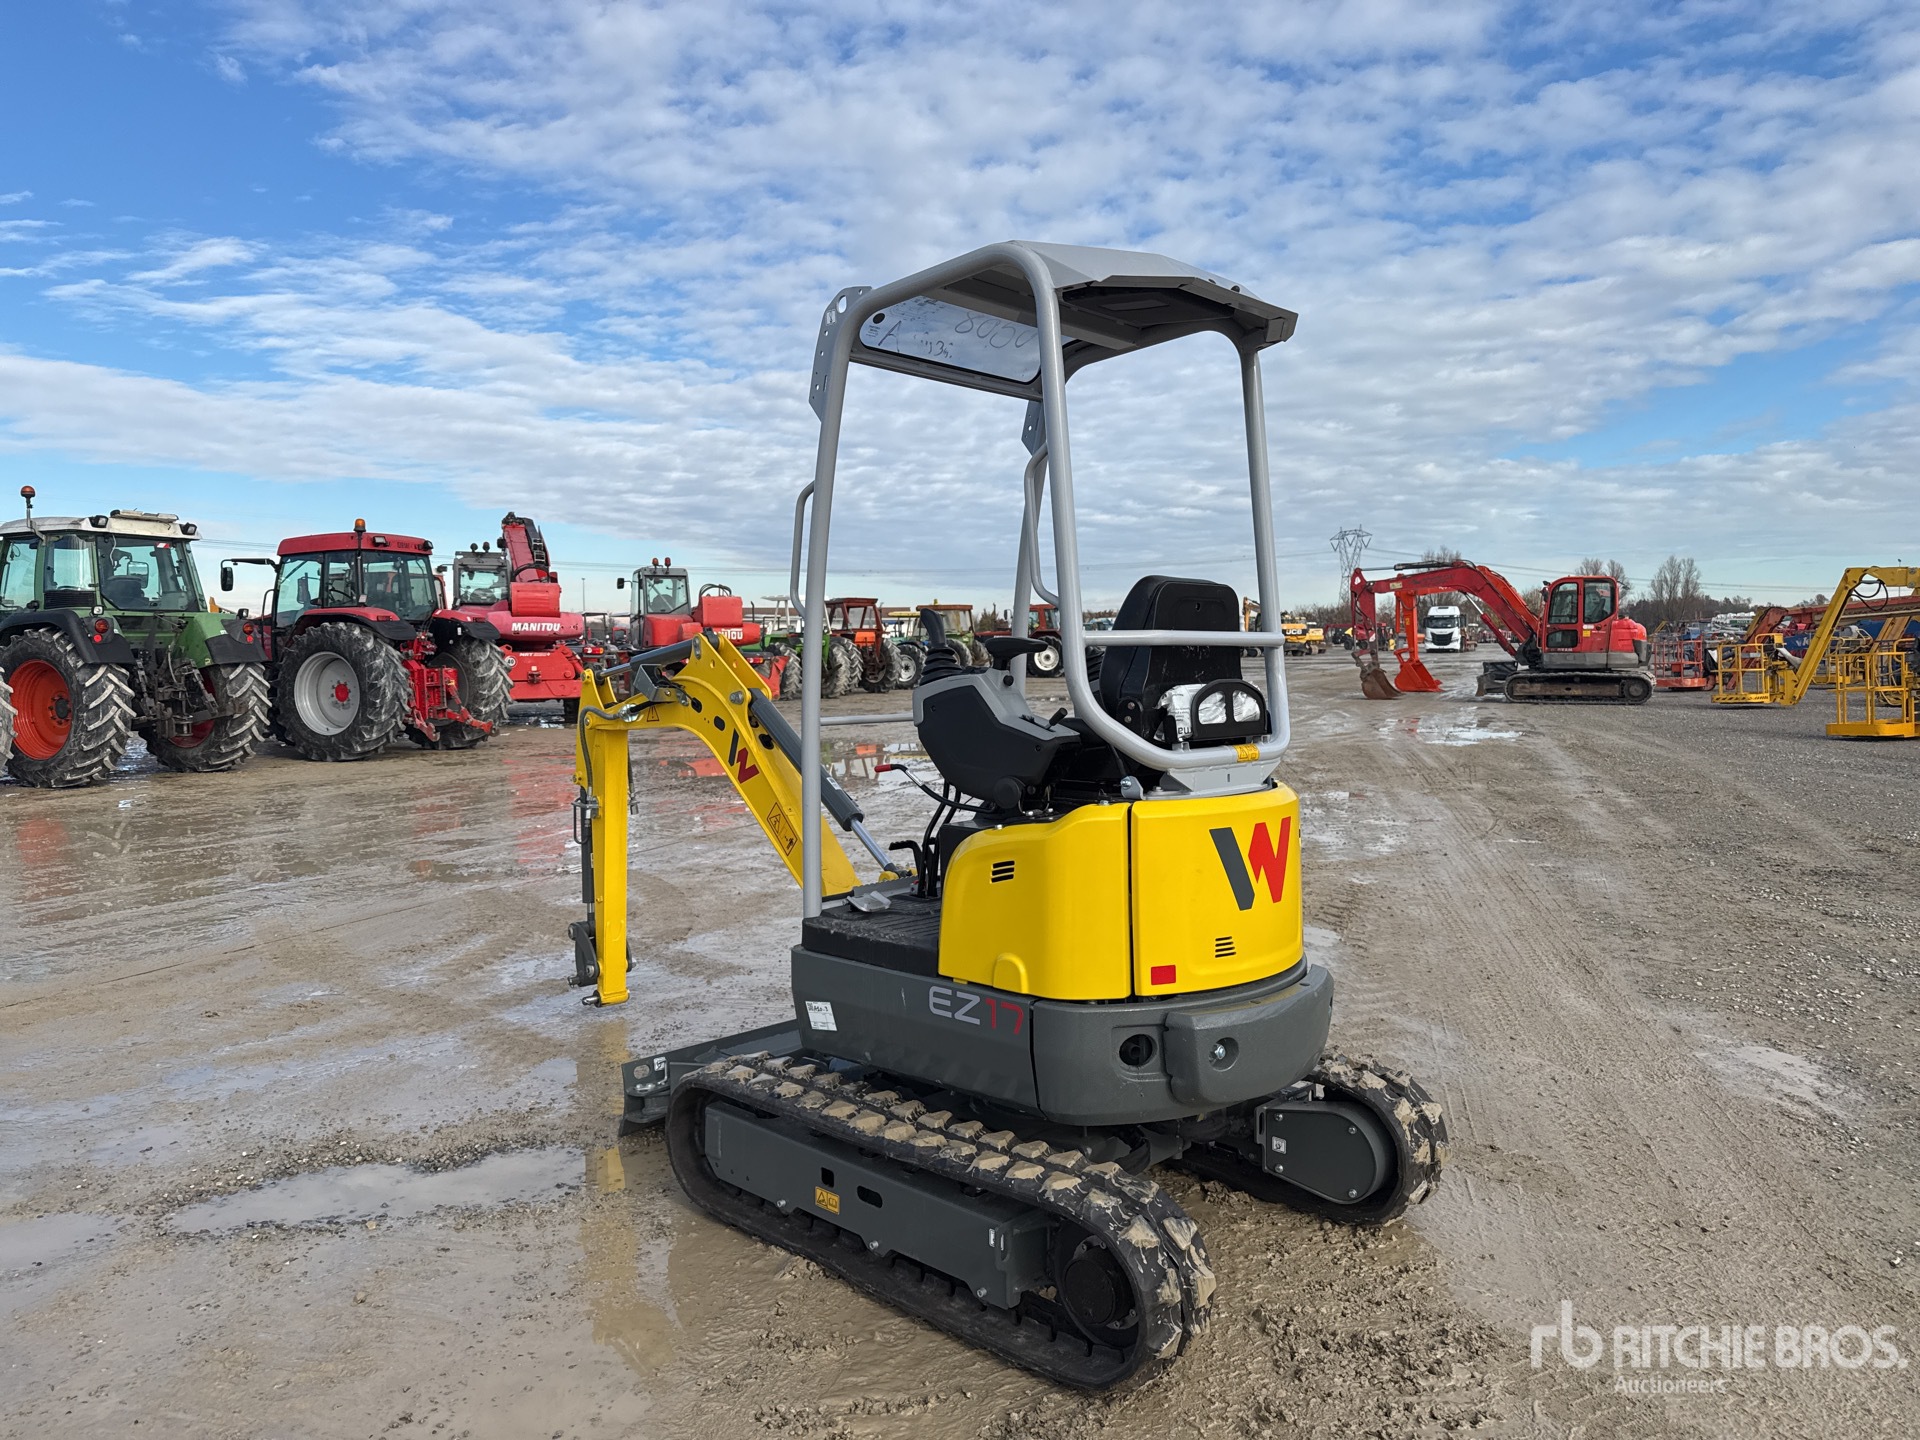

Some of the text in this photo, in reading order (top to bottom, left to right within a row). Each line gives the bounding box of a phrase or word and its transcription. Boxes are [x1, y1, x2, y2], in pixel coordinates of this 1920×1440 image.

[511, 622, 561, 632] MANITOU
[1208, 815, 1292, 912] W
[928, 985, 1025, 1036] EZ17
